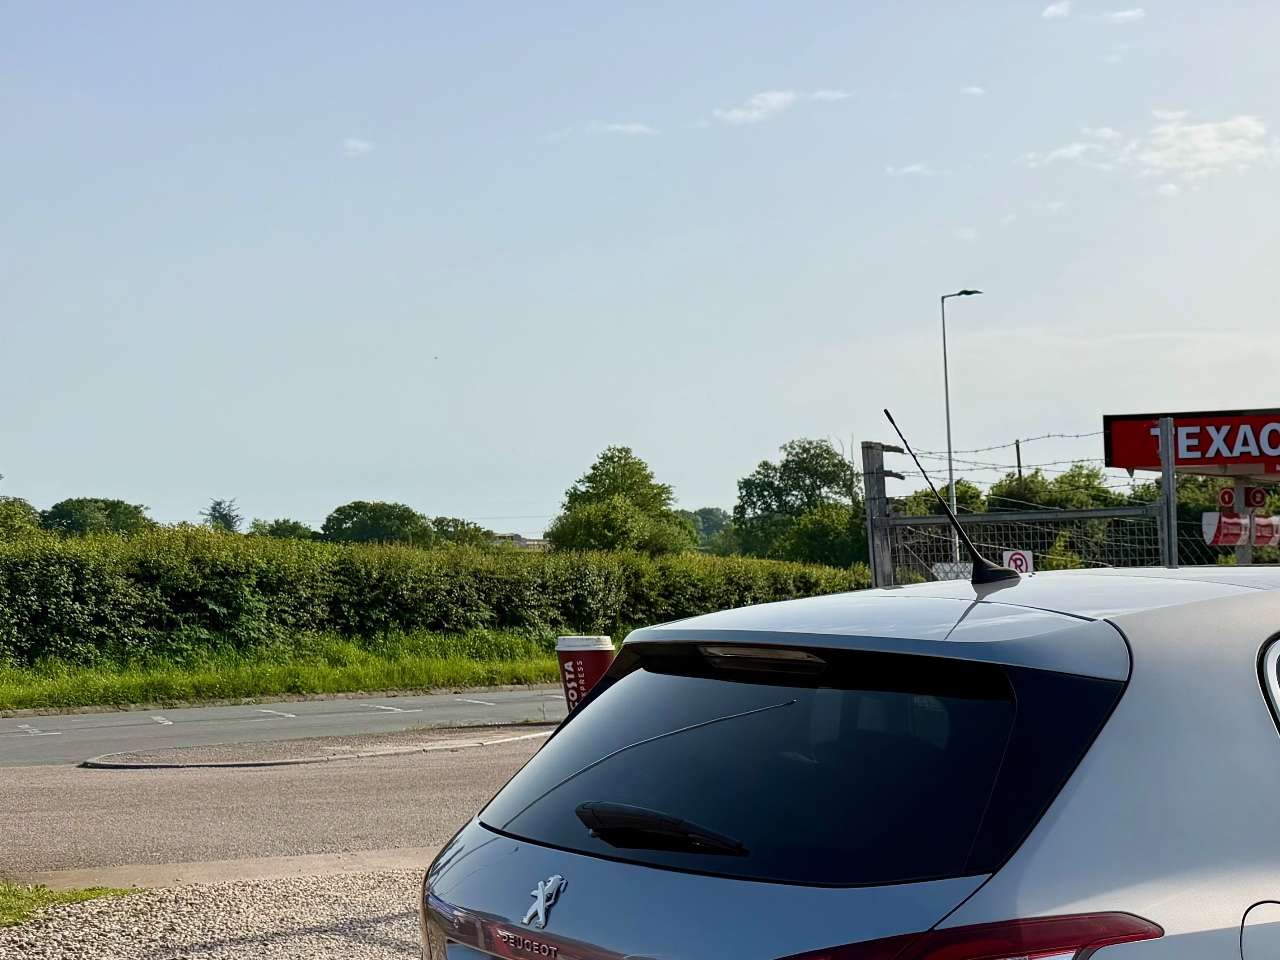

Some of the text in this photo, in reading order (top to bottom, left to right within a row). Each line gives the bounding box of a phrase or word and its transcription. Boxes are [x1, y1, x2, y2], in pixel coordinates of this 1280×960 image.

[564, 661, 578, 710] COSTA
[577, 660, 586, 697] XPRESS
[496, 929, 559, 959] PEUGEOT
